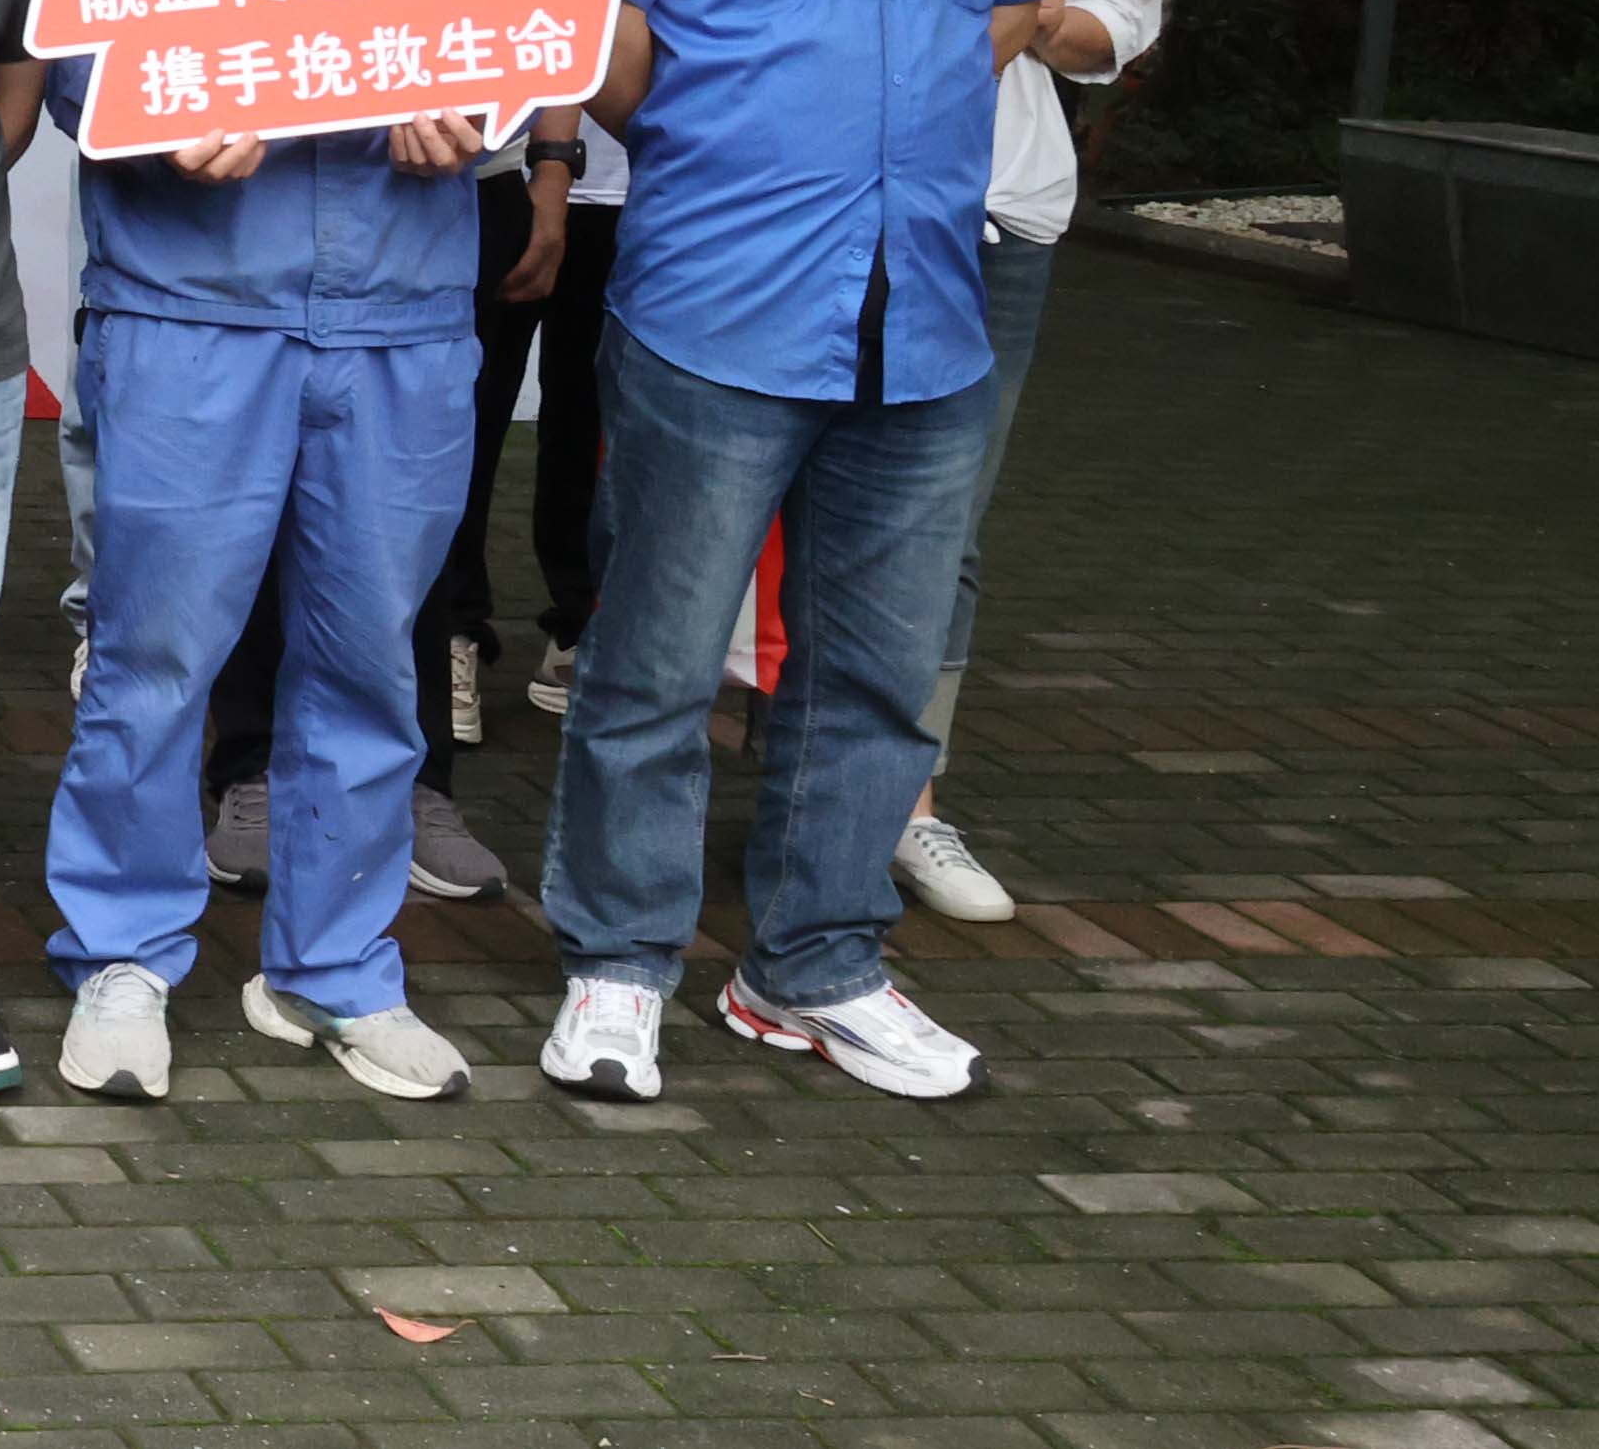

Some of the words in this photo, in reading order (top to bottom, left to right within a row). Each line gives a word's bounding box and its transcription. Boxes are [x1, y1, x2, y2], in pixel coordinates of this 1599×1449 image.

[140, 8, 577, 116] 携手挽救生命
